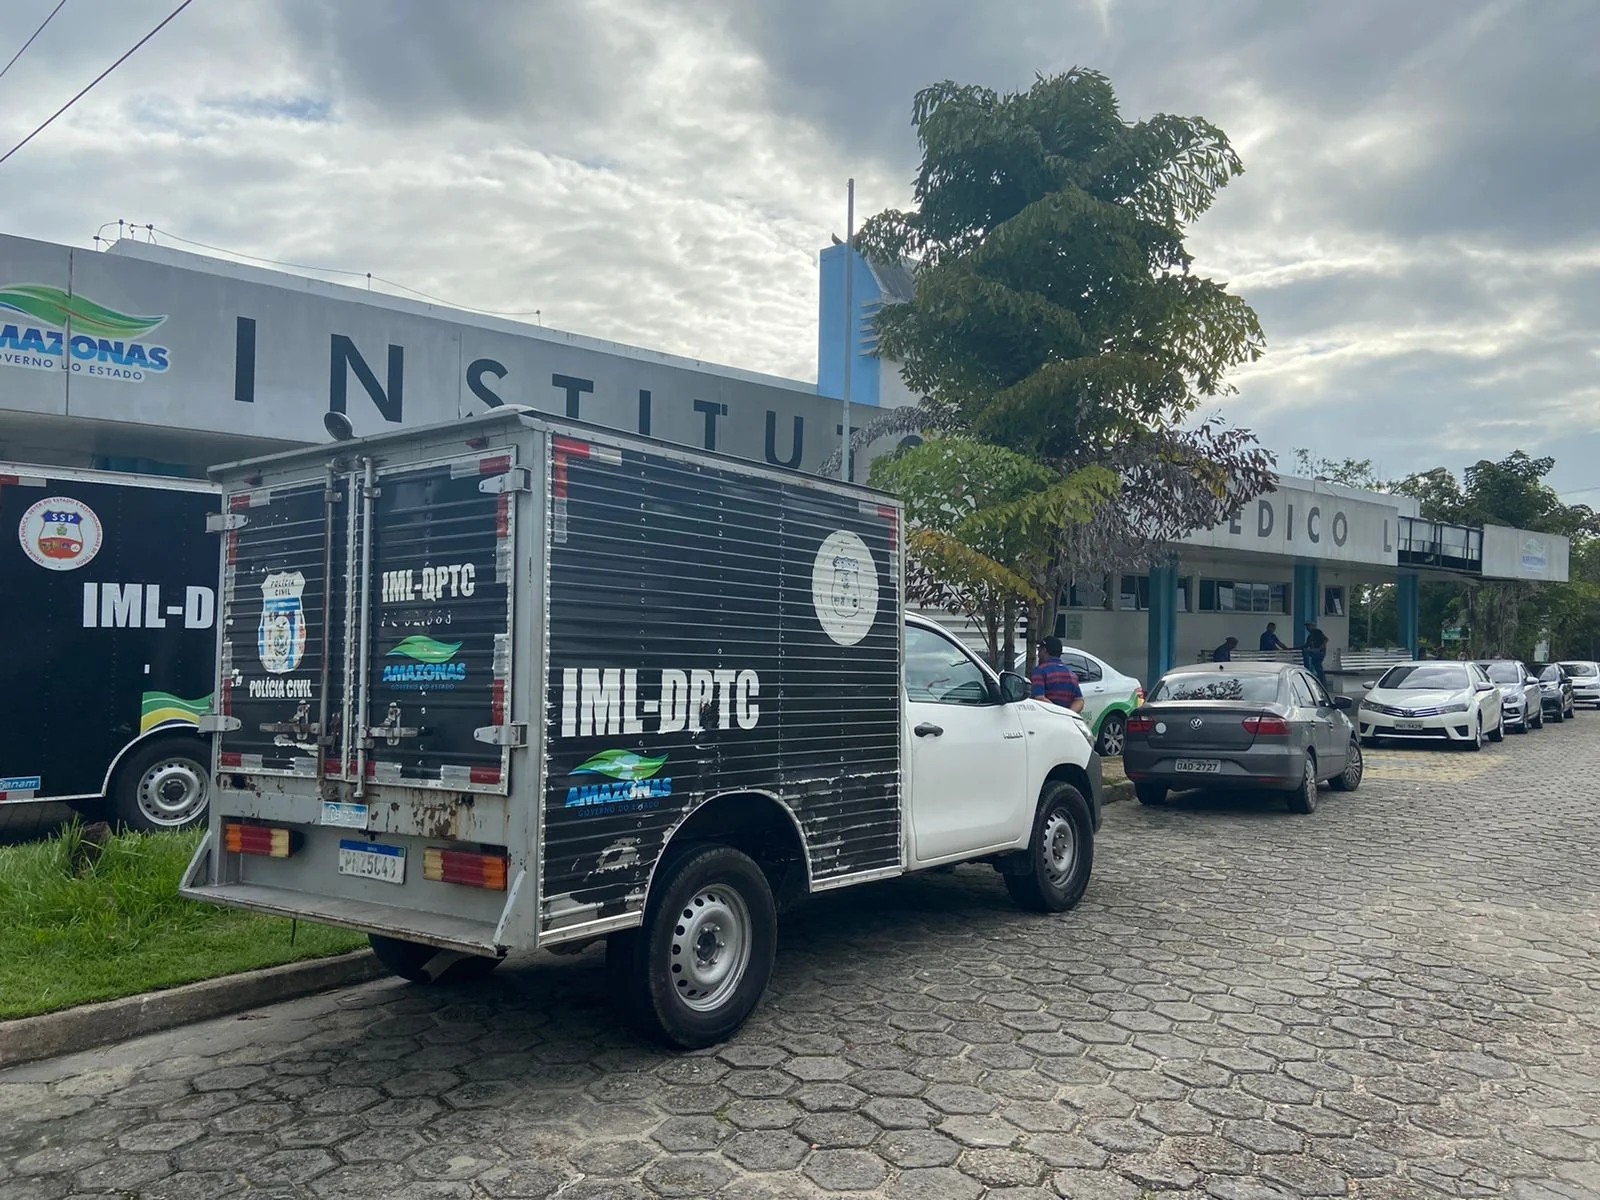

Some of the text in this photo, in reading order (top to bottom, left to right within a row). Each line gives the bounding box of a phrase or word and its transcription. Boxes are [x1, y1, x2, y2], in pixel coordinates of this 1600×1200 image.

[0, 325, 169, 372] MAZONAS
[0, 353, 54, 369] VERNO
[89, 365, 143, 380] ESTADO
[235, 316, 924, 482] INSTITU
[52, 513, 74, 522] SSP
[1229, 499, 1348, 547] EDICO
[275, 588, 291, 596] CIVIL
[382, 662, 466, 682] AMAZONAS
[249, 677, 313, 698] POLÍCIA CIVIL
[562, 667, 760, 737] IML-DPTC
[565, 778, 673, 807] AMAZONAS
[578, 805, 615, 817] GOVERNO
